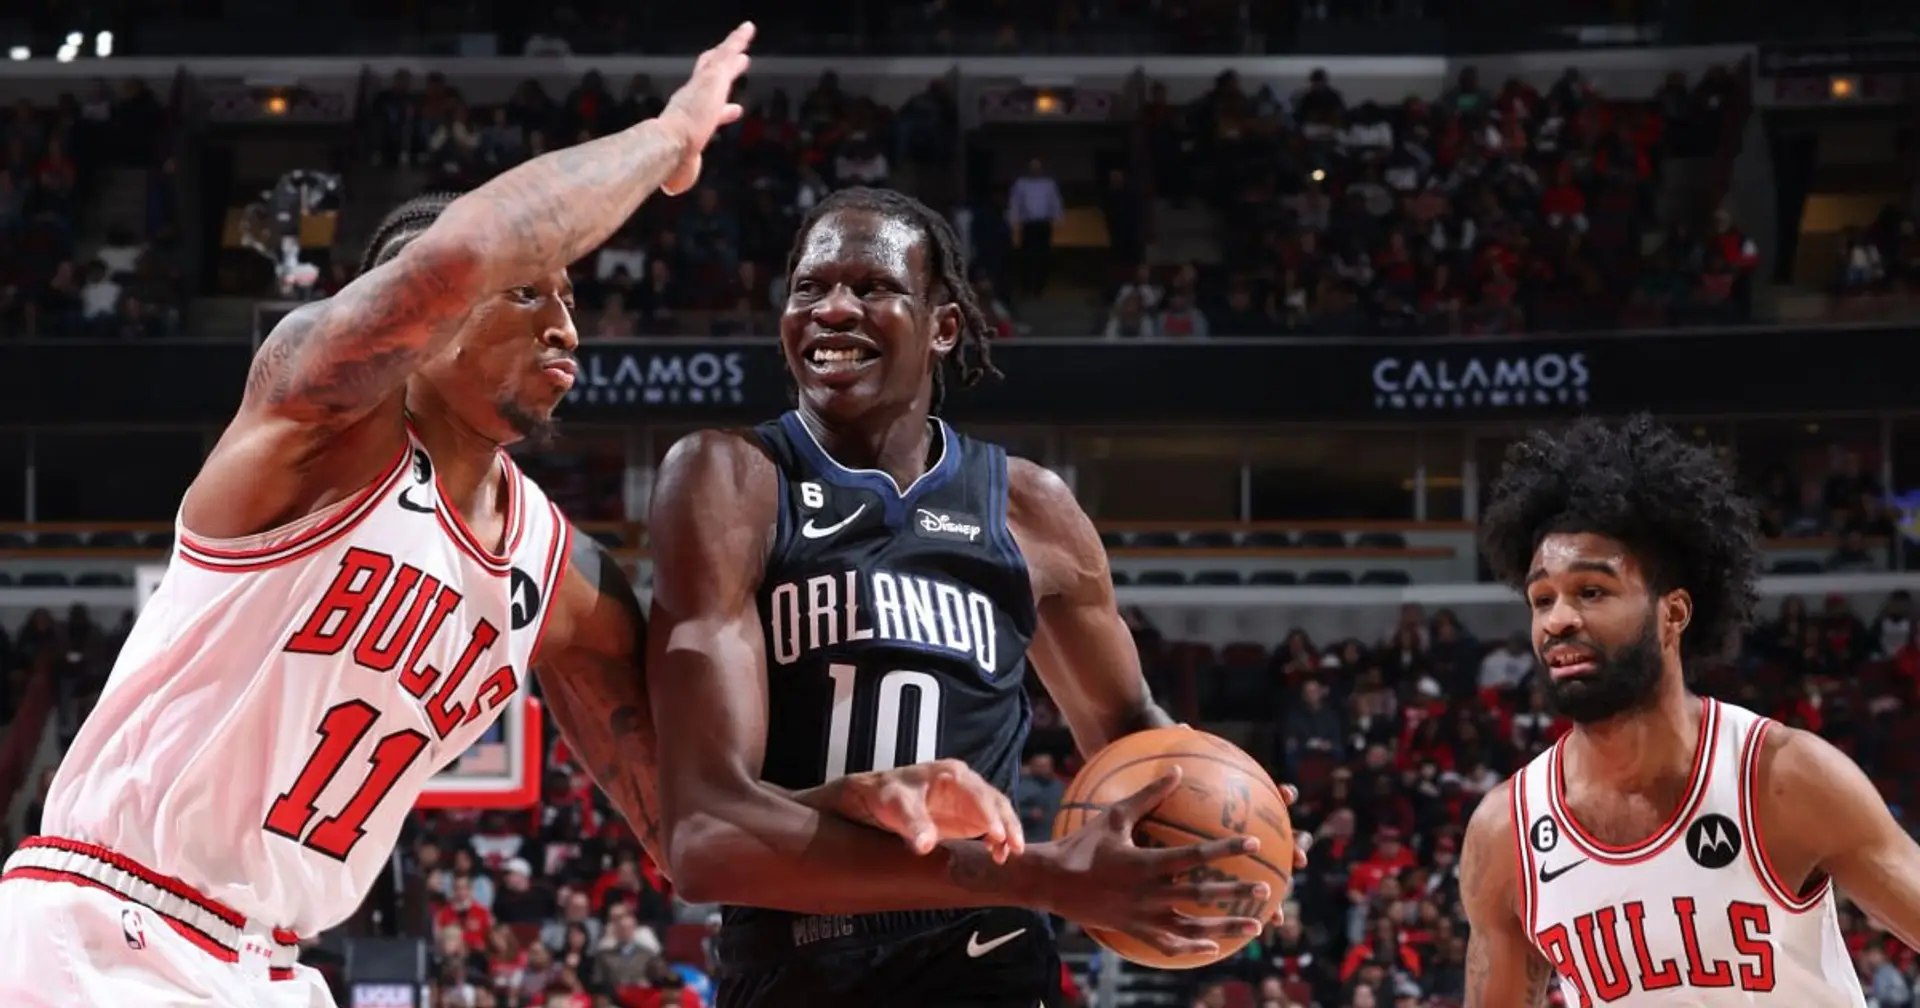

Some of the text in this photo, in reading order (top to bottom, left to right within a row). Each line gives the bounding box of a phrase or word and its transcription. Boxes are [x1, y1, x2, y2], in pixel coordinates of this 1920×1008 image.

[1372, 353, 1590, 391] CALAMOS
[801, 482, 824, 509] 6
[916, 508, 982, 541] Disney
[771, 570, 997, 674] ORLANDO
[825, 663, 941, 786] 10
[262, 698, 431, 863] 11
[1537, 819, 1556, 850] 6
[1536, 897, 1776, 1008] BULLS
